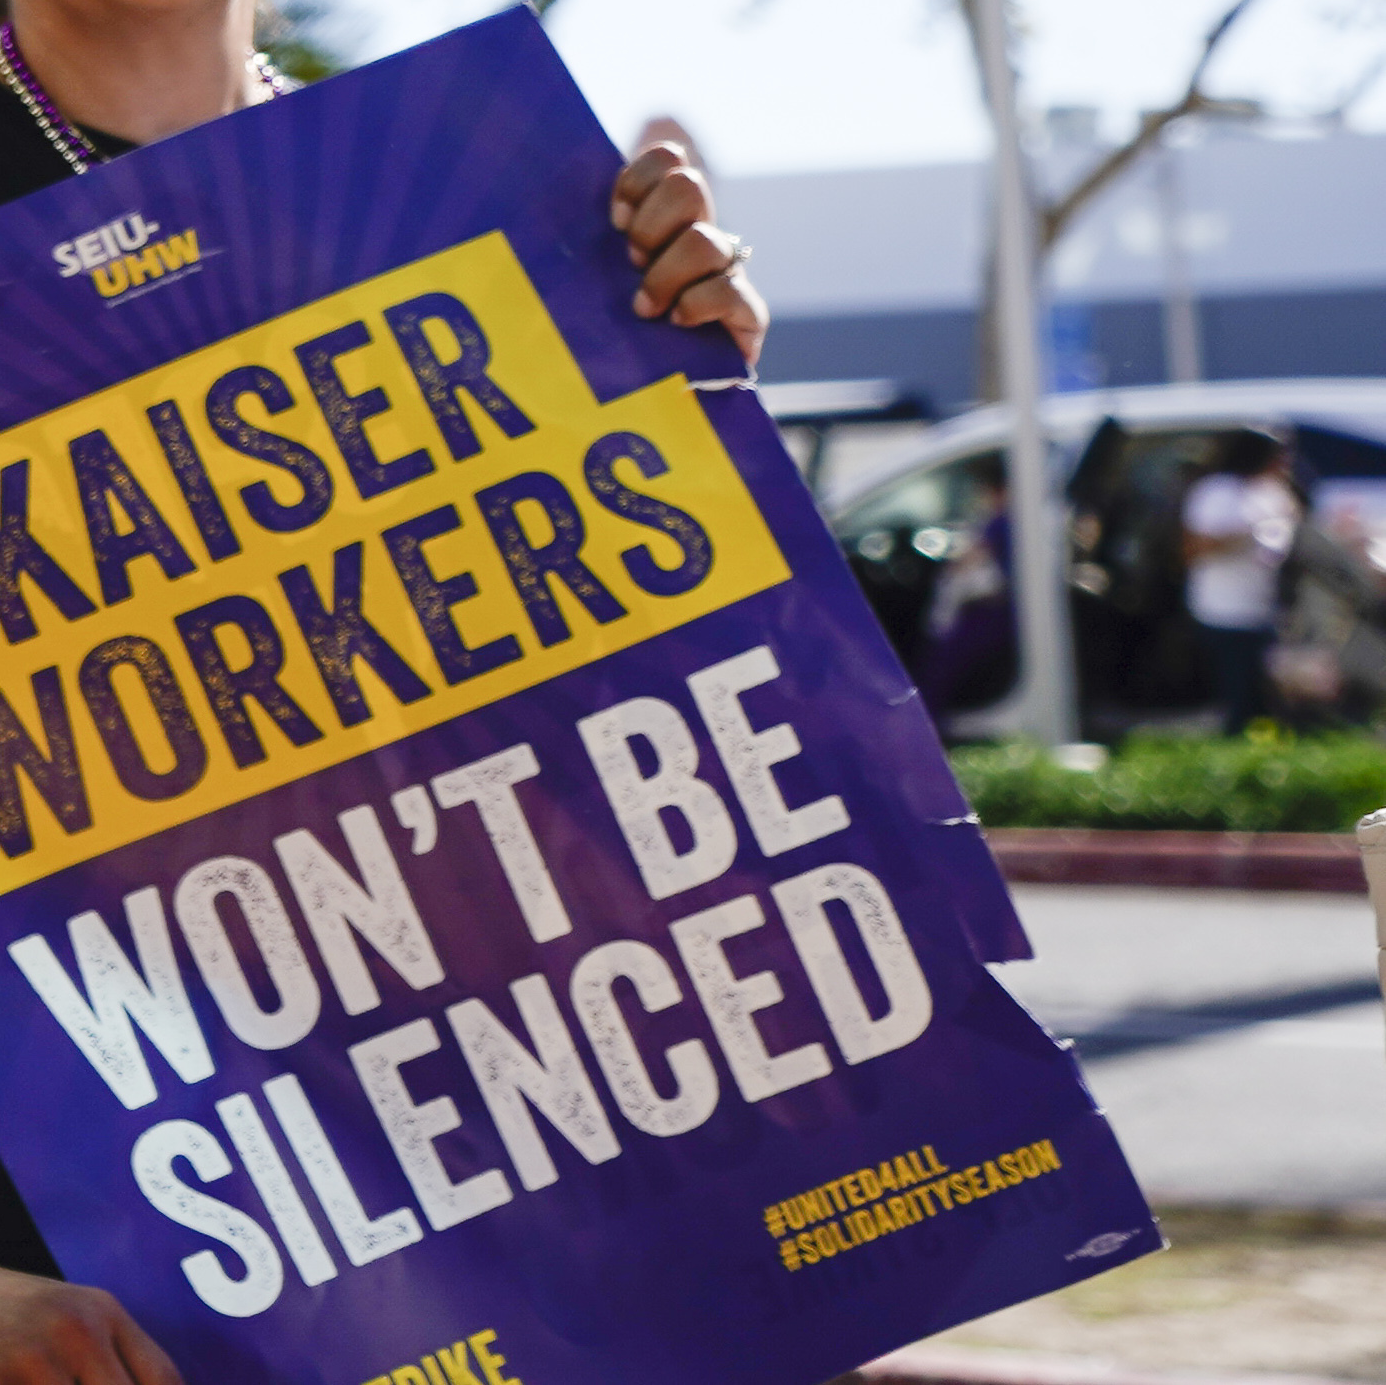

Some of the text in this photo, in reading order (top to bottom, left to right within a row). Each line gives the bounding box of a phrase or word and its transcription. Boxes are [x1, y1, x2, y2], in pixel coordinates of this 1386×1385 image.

[91, 228, 201, 298] UHW
[578, 645, 851, 901] BE
[131, 862, 933, 1319] SILENCED
[764, 1144, 949, 1239] #UNITED4ALL
[778, 1138, 1062, 1272] #SOLIDARITYSEASON
